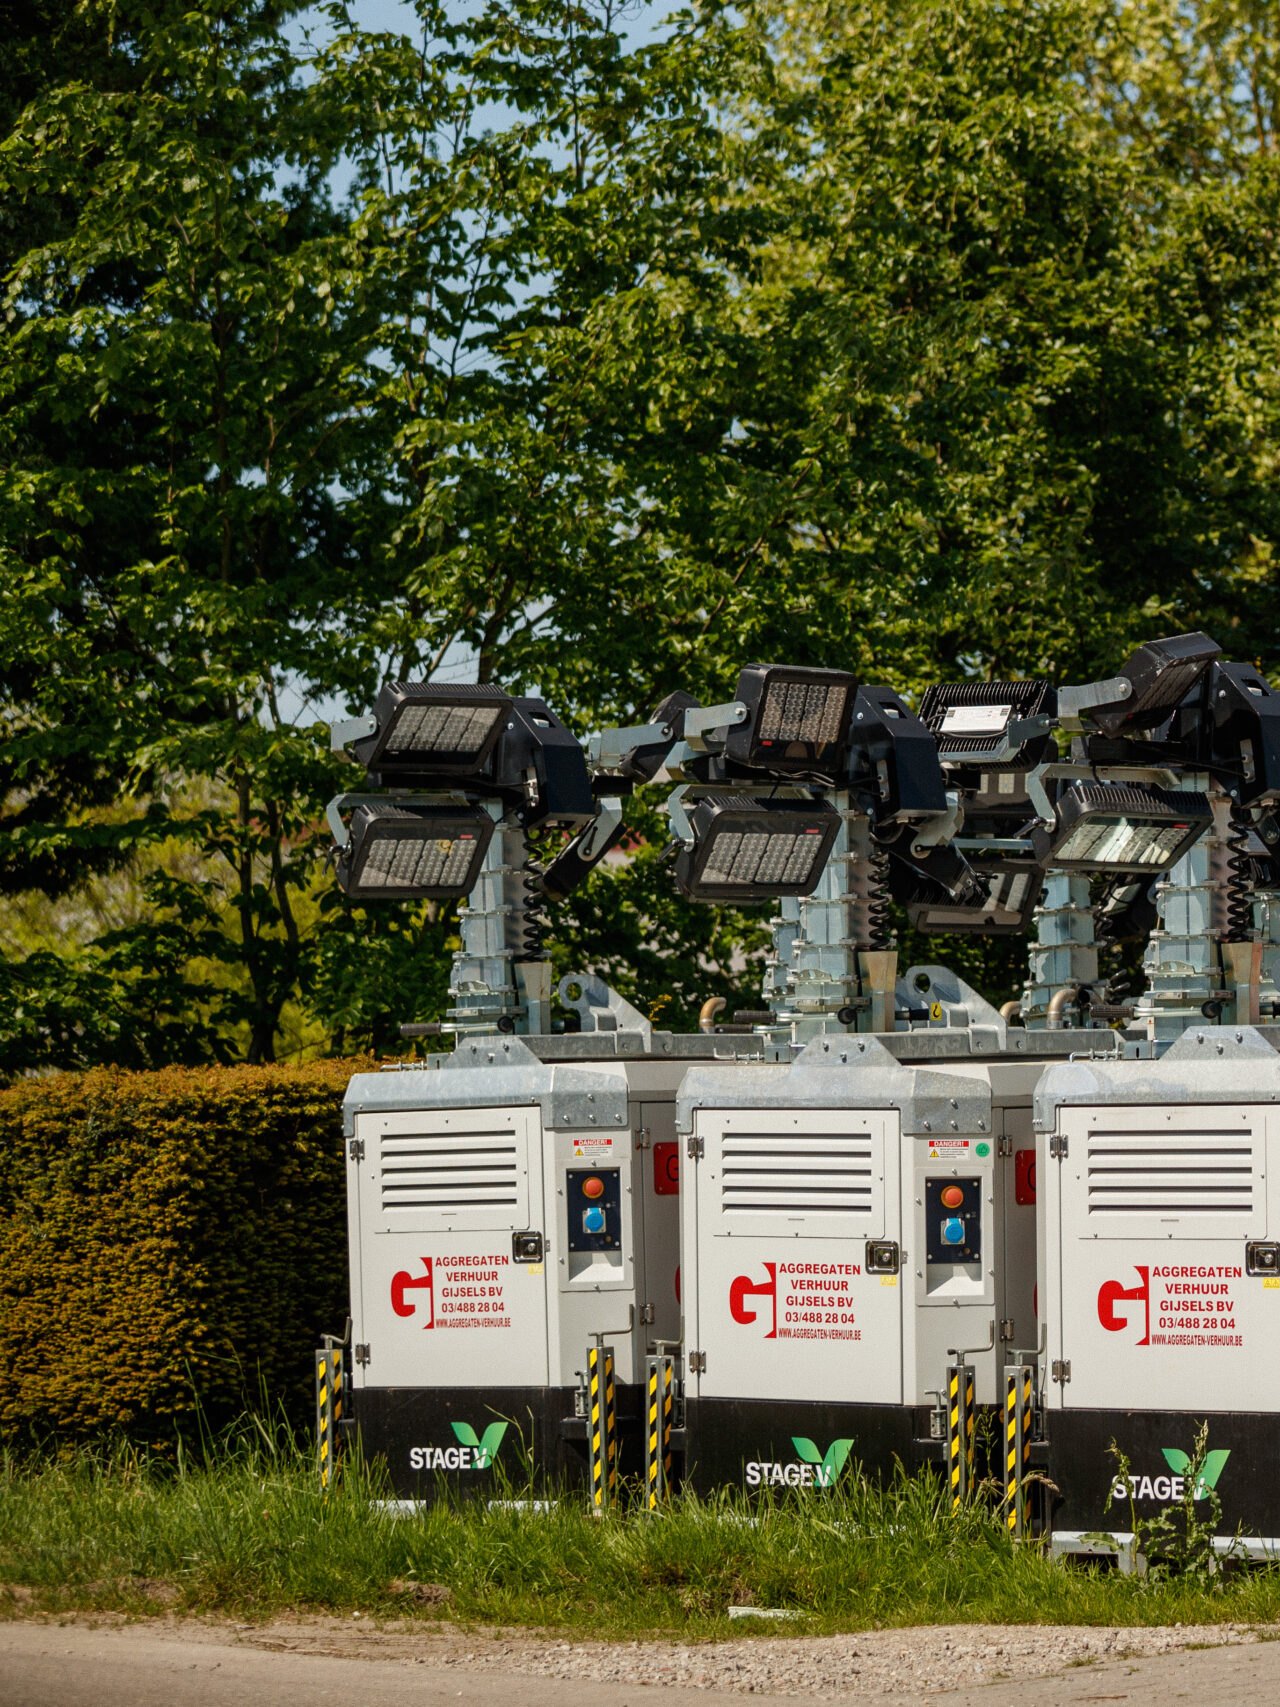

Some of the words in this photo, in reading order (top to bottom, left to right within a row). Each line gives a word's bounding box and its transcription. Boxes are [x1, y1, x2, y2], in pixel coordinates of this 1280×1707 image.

[435, 1256, 509, 1266] AGGREGATEN
[779, 1263, 861, 1275] AGGREGATEN
[1152, 1266, 1242, 1277] AGGREGATEN
[446, 1271, 498, 1282] VERHUUR
[791, 1280, 849, 1291] VERHUUR
[1165, 1283, 1229, 1294] VERHUUR
[442, 1287, 486, 1297] GIJSELS
[489, 1287, 503, 1296] BV
[786, 1296, 835, 1307] GIJSELS
[838, 1297, 853, 1307] BV
[1160, 1301, 1213, 1312] GIJSELS
[1216, 1301, 1234, 1312] BV
[442, 1303, 475, 1313] 03/488
[478, 1303, 489, 1312] 28
[492, 1302, 504, 1312] 04
[785, 1312, 822, 1323] 03/488
[825, 1313, 838, 1324] 28
[841, 1313, 855, 1324] 04
[1159, 1317, 1200, 1329] 03/488
[1203, 1317, 1217, 1329] 28
[1220, 1318, 1235, 1329] 04
[778, 1328, 861, 1340] WWW.AGGREGATEN-VERHUUR.BE
[1152, 1334, 1243, 1346] WWW.AGGREGATEN-VERHUUR.BE
[410, 1447, 471, 1469] STAGE
[473, 1447, 487, 1469] V
[746, 1462, 813, 1487] STAGE
[815, 1465, 831, 1487] V
[1112, 1475, 1185, 1500] STAGE
